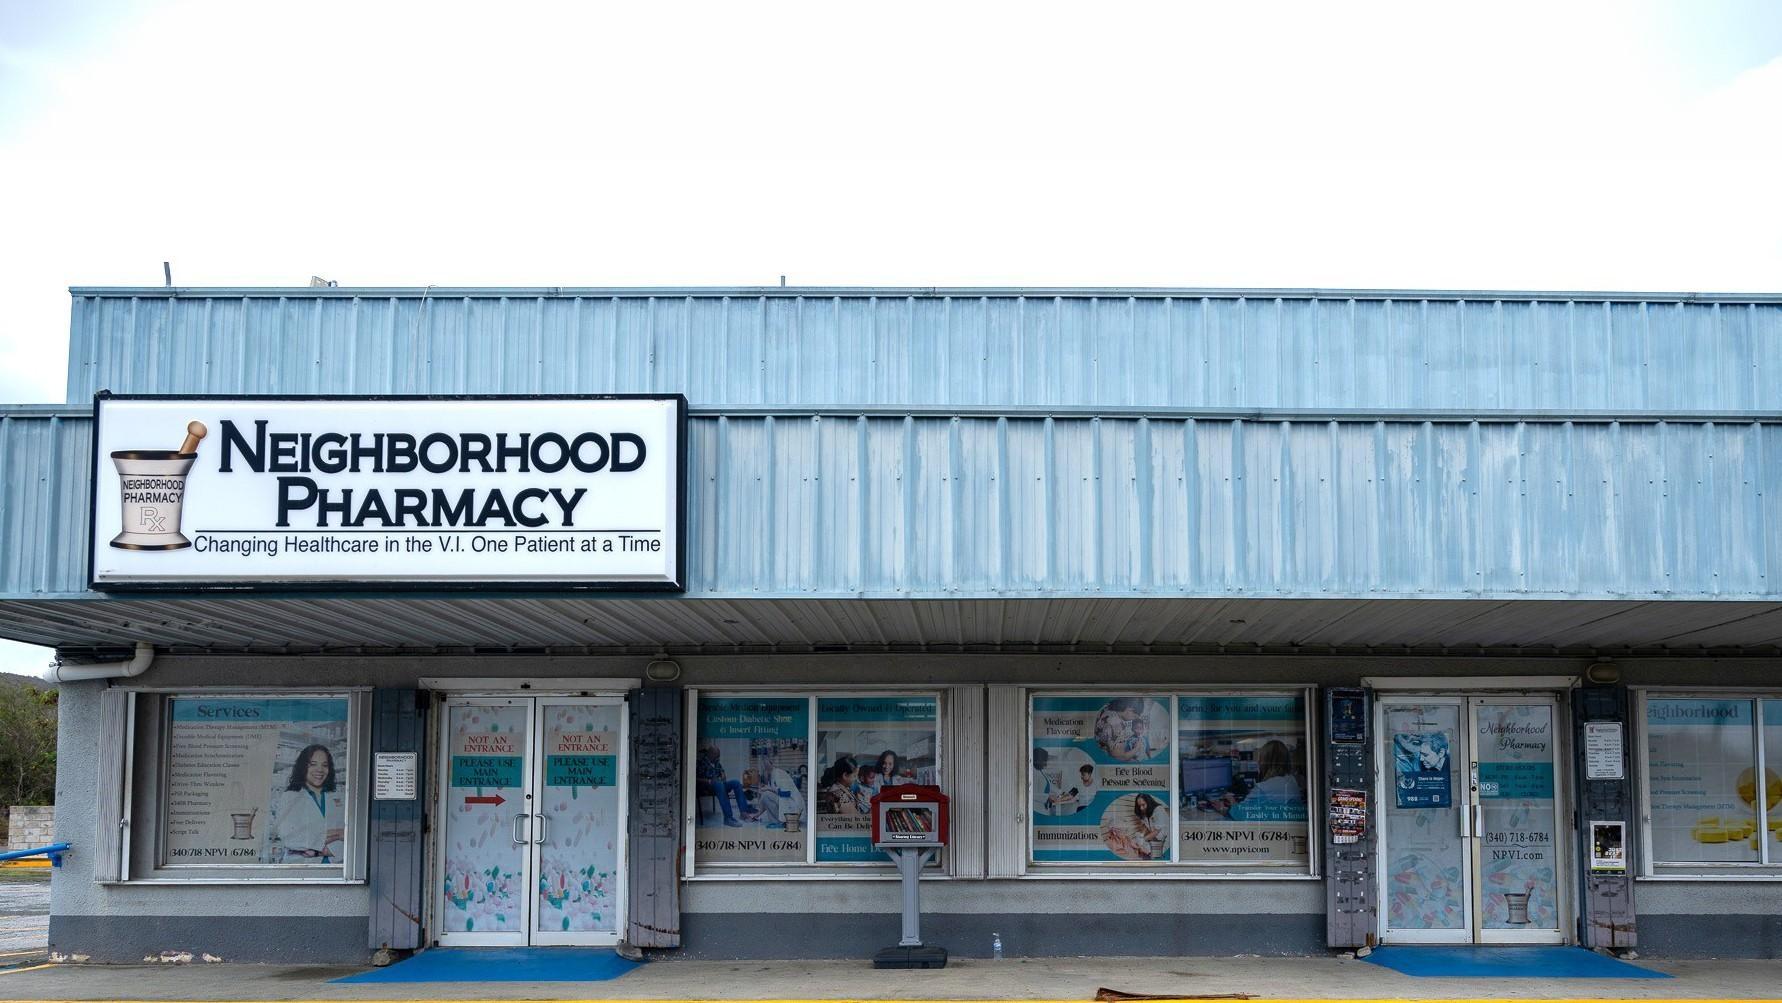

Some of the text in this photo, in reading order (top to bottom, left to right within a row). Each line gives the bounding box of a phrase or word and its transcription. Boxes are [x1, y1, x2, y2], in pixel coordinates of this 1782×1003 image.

[219, 420, 647, 473] NEIGHBORHOOD
[123, 479, 185, 491] NEIGHBORHOOD
[124, 493, 183, 504] PHARMACY
[276, 476, 588, 528] PHARMACY
[195, 536, 660, 557] Changing Healthcare in the V.I. One Patient at a Time
[197, 705, 260, 718] Services
[1647, 705, 1738, 721] eighborhood
[1044, 718, 1084, 726] Medication
[1047, 728, 1081, 736] Flavoring
[1480, 721, 1548, 736] Neighborhood
[468, 735, 507, 743] NOT AN
[562, 735, 601, 743] NOT AN
[464, 744, 514, 753] ENTRANCE
[558, 743, 609, 752] ENTRANCE
[1498, 737, 1546, 752] Pharmacy
[460, 759, 516, 768] PLEASE USE
[554, 758, 610, 767] PLEASE USE
[473, 768, 498, 777] MAIN
[568, 767, 592, 776] MAIN
[1132, 767, 1153, 776] Blood
[460, 777, 512, 786] ENTRANCE
[554, 776, 606, 785] ENTRANCE
[1037, 830, 1098, 840] Immunizations
[1258, 831, 1290, 842] (6784)
[1485, 832, 1549, 845] (340) 718-6784
[769, 840, 802, 851] (6784)
[842, 844, 868, 853] Home
[1492, 850, 1543, 860] NPVI.com
